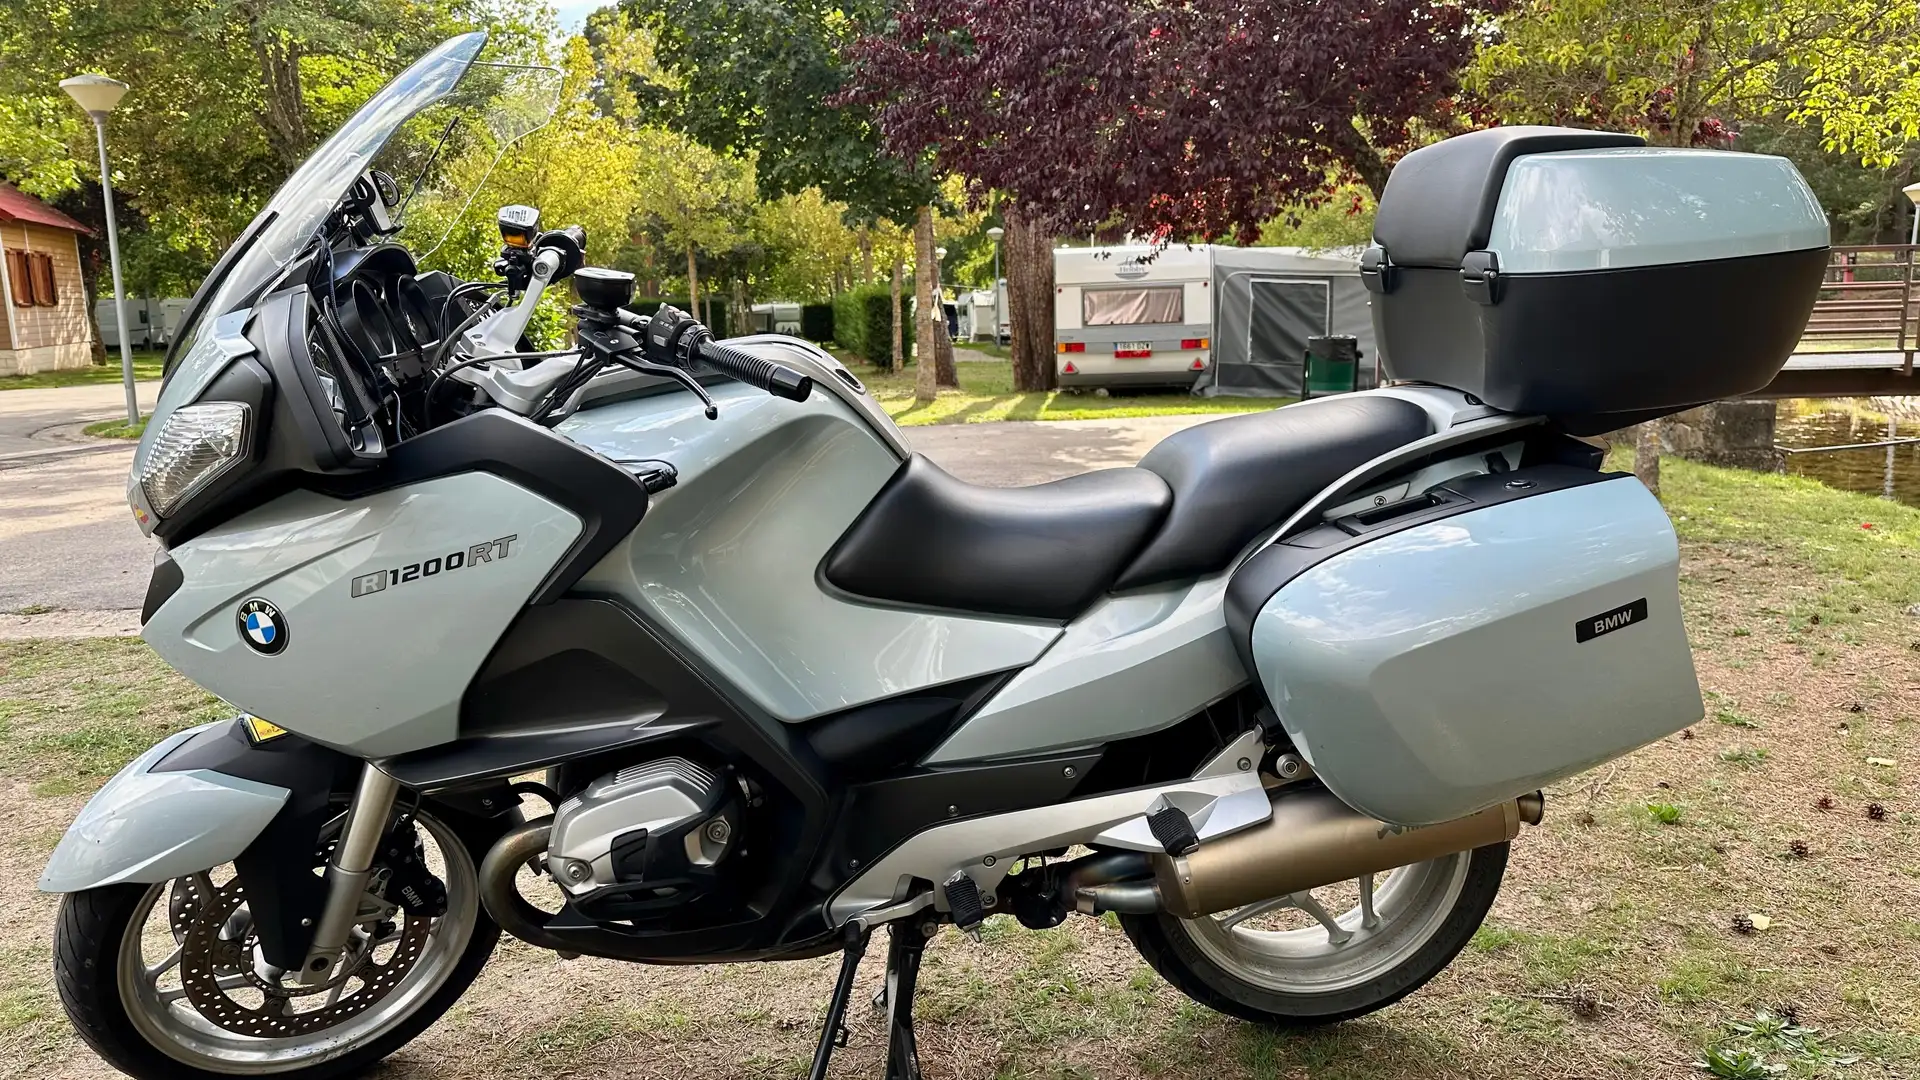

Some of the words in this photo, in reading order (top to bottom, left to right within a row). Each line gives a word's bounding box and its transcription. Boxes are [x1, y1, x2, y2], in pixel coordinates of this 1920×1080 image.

[240, 602, 276, 622] BMW
[1594, 609, 1632, 634] BMW
[401, 885, 424, 907] BMW
